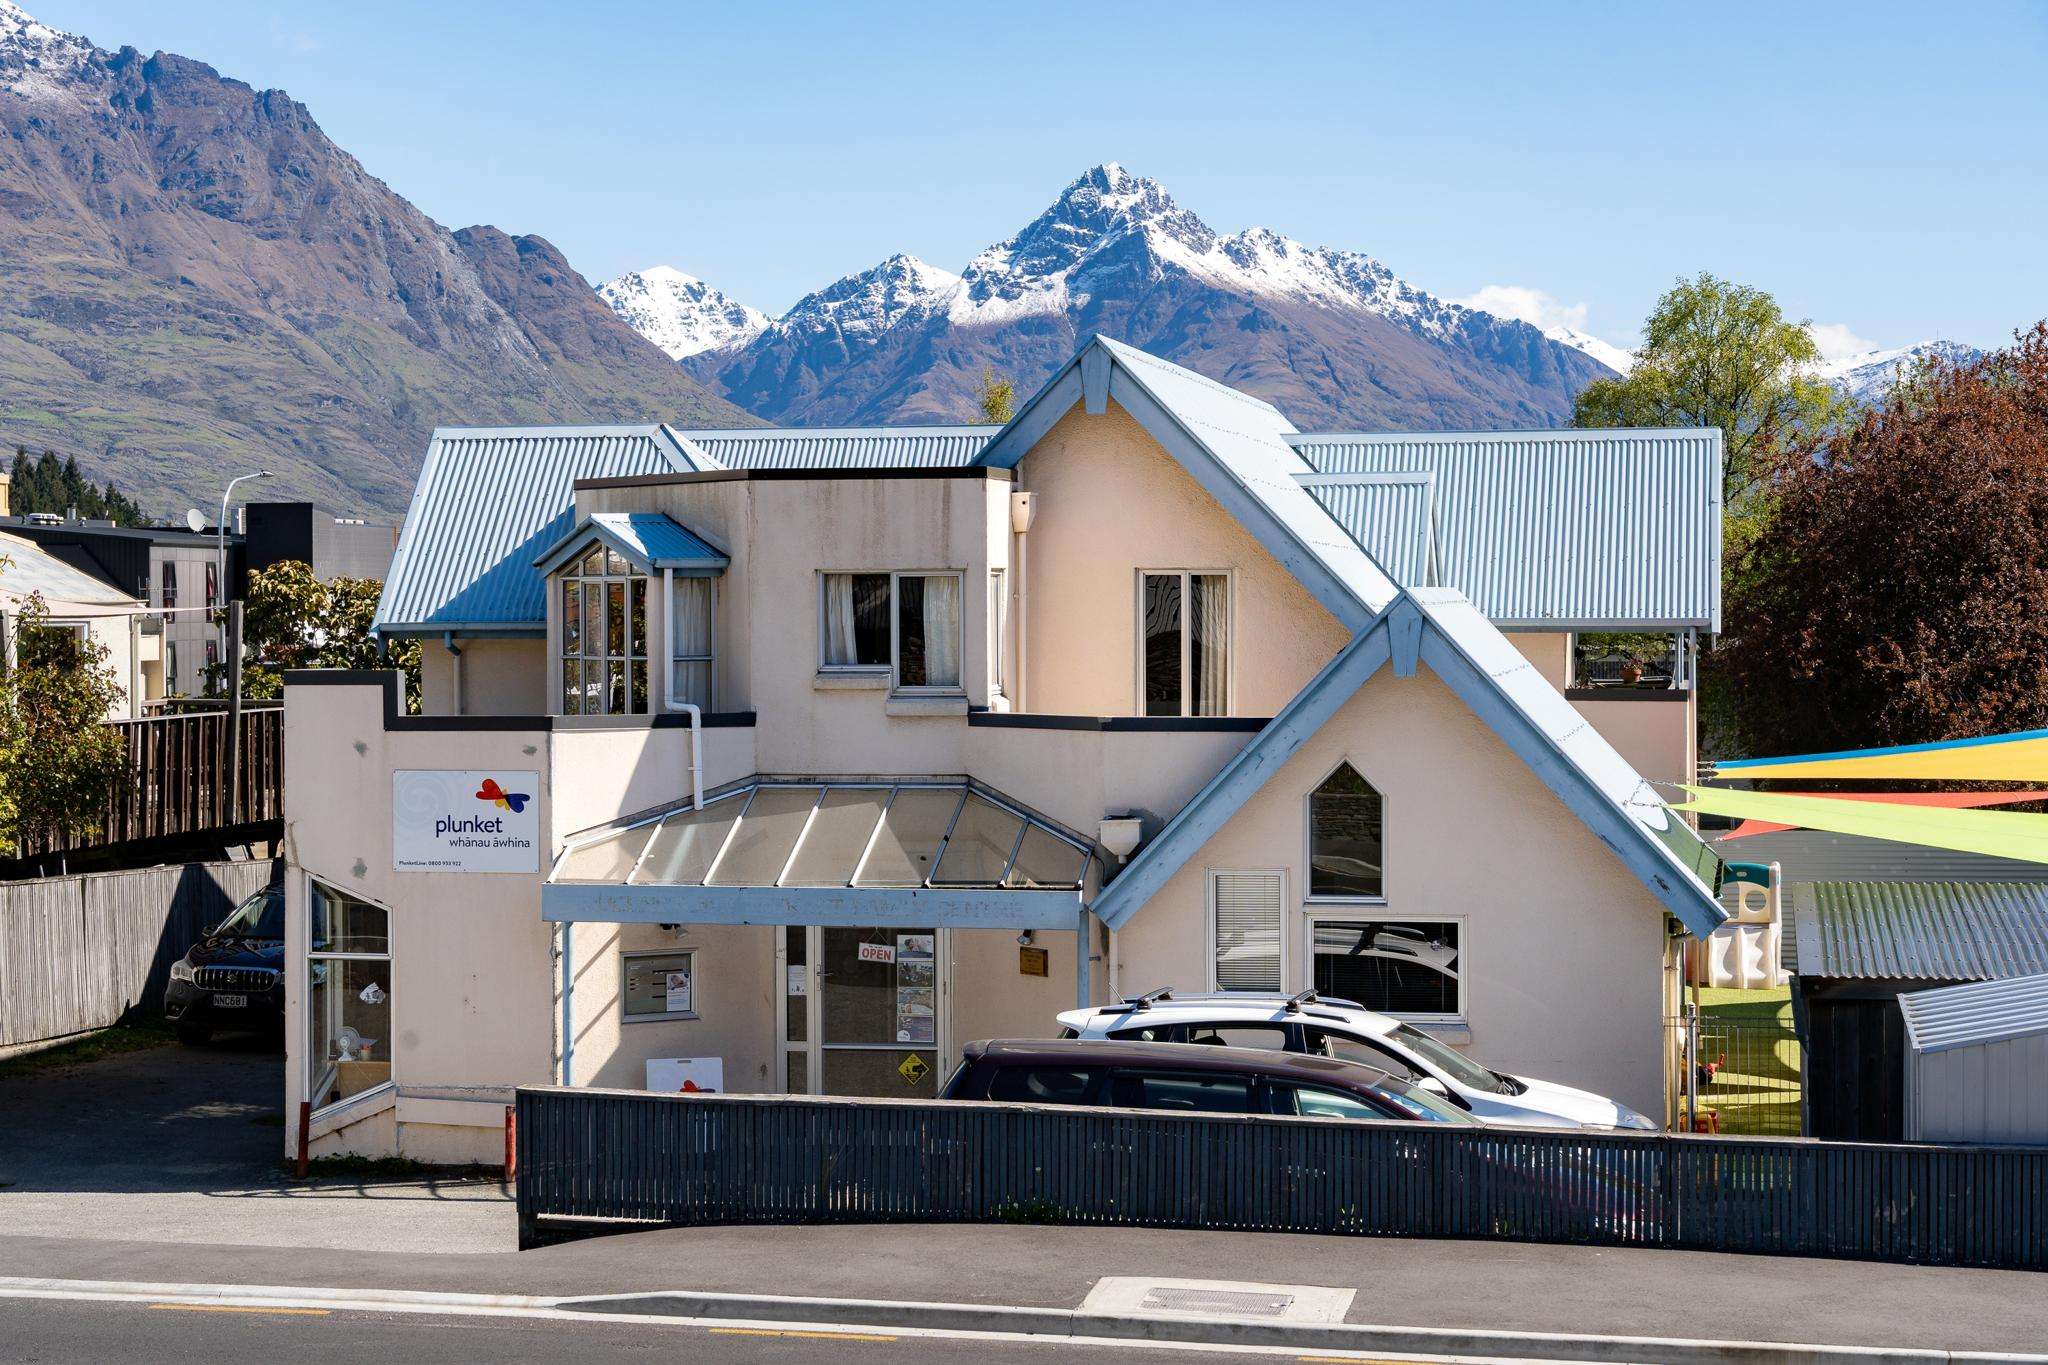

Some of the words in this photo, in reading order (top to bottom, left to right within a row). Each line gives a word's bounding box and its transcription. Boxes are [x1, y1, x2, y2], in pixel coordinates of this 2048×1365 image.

[435, 814, 503, 838] plunket
[449, 836, 490, 848] whānau
[493, 836, 530, 848] āwhina
[862, 947, 892, 961] OPEN
